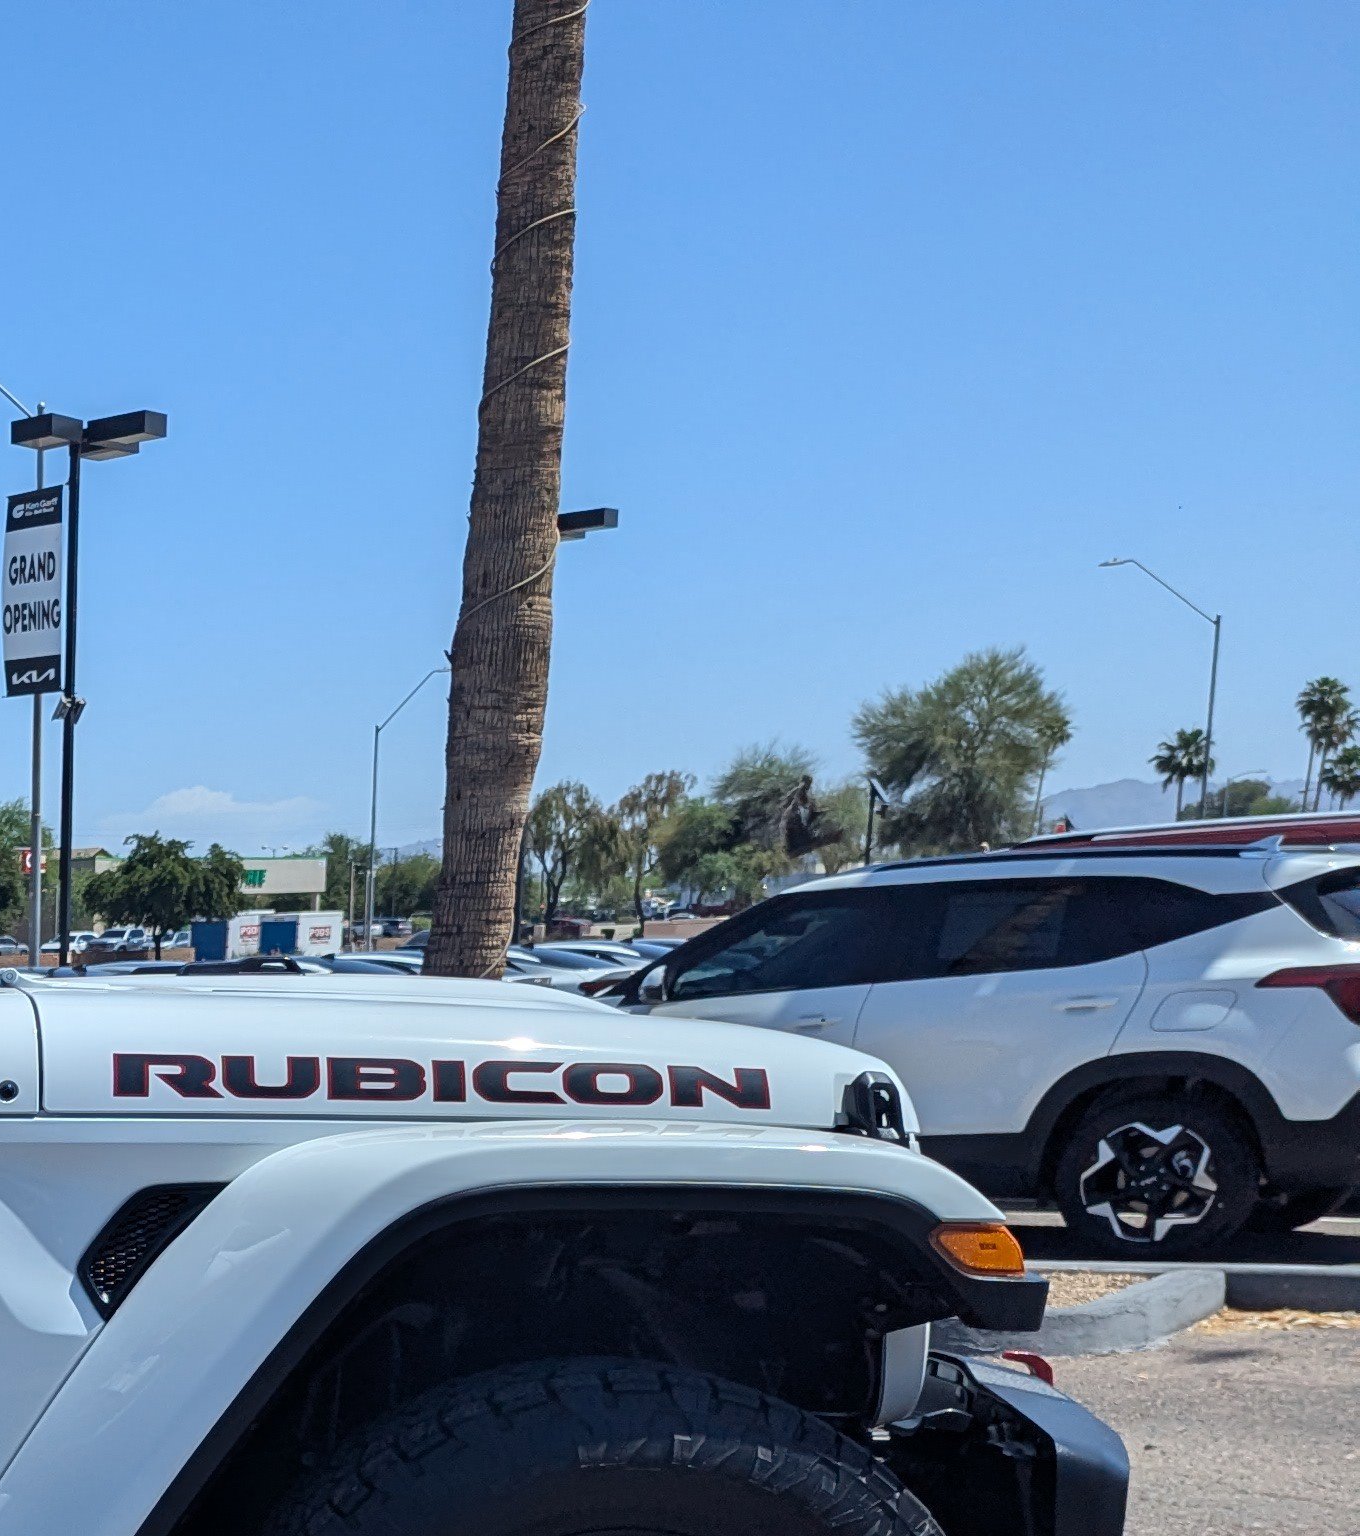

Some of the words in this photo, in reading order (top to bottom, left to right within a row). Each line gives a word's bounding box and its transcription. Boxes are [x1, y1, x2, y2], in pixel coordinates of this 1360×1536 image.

[9, 551, 56, 586] GRAND
[3, 598, 61, 635] OPENING
[11, 667, 56, 685] KIA
[112, 1052, 771, 1110] RUBICON
